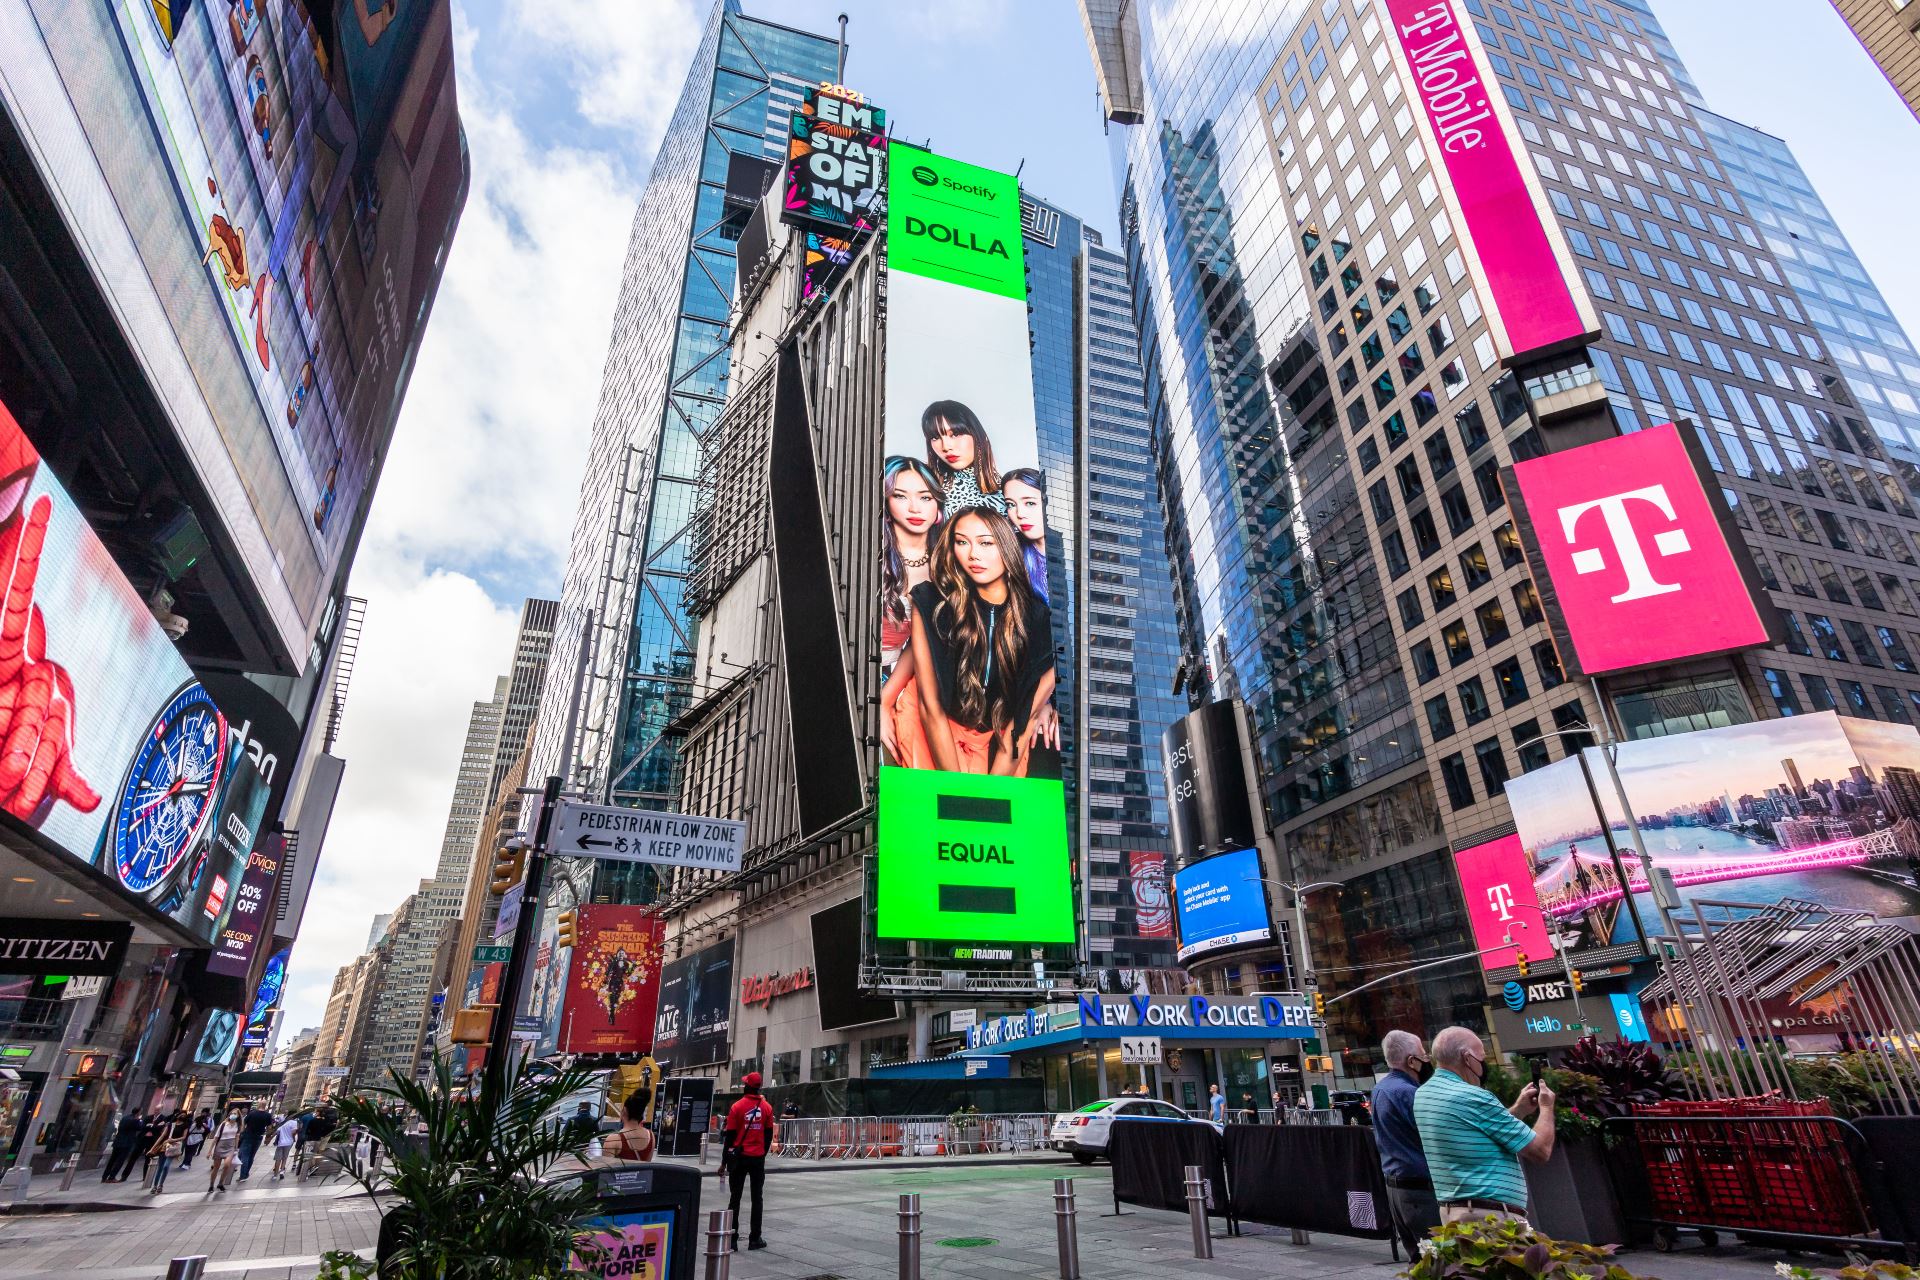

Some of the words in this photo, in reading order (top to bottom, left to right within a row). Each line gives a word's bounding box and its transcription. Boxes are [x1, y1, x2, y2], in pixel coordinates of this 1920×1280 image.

[819, 81, 864, 103] 2021
[817, 96, 872, 132] EM
[809, 152, 869, 188] OF
[942, 177, 997, 201] Spotify
[905, 215, 1010, 260] DOLLA
[1557, 484, 1691, 604] T
[227, 812, 252, 849] CITIZEN
[579, 811, 663, 835] PEDESTRIAN
[665, 821, 700, 838] FLOW
[704, 824, 737, 843] ZONE
[648, 840, 682, 858] KEEP
[687, 843, 735, 864] MOVING
[937, 841, 1014, 865] EQUAL
[240, 883, 262, 900] 30%
[1220, 894, 1231, 904] app
[1487, 883, 1515, 921] T
[237, 898, 258, 914] OFF
[226, 938, 244, 950] NY30
[235, 931, 253, 943] CODE
[1209, 937, 1231, 948] CHASE
[478, 947, 487, 959] W
[491, 948, 507, 960] 43
[1528, 980, 1567, 1002] AT&T
[658, 1008, 679, 1033] NYC
[1079, 994, 1130, 1026] NEW
[1130, 994, 1188, 1026] YORK
[1190, 995, 1259, 1027] POLICE
[1259, 996, 1312, 1027] DEPT
[1000, 1016, 1025, 1042] POLICE
[1026, 1008, 1050, 1036] DEPT
[1525, 1016, 1562, 1033] Hello
[617, 1242, 657, 1260] ARE
